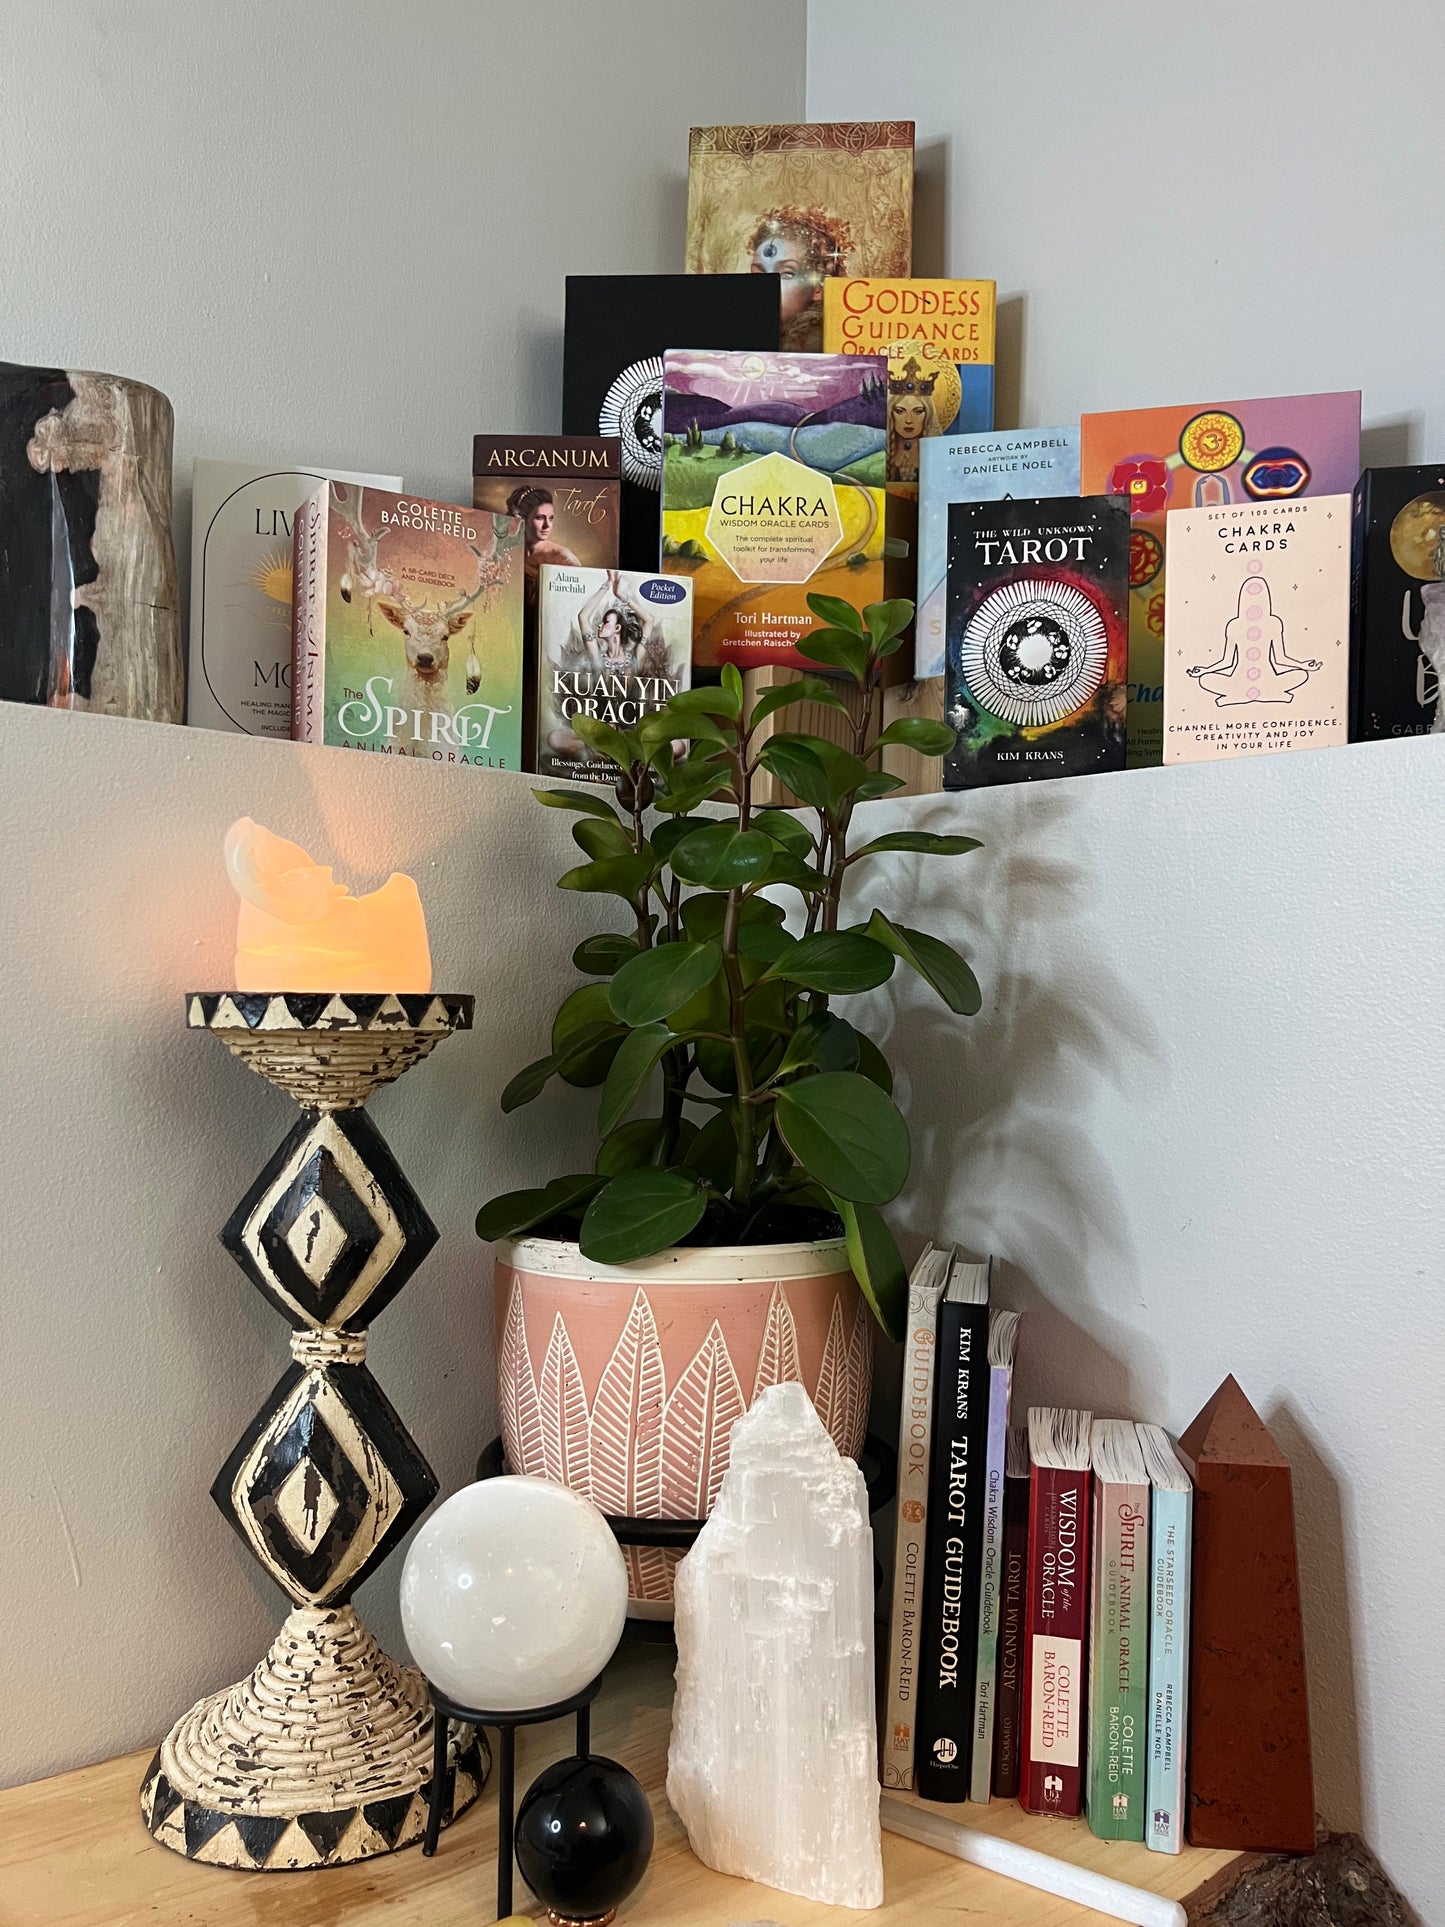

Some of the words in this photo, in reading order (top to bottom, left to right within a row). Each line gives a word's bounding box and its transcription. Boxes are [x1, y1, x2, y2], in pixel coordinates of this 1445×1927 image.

[843, 280, 980, 316] GODDESS
[842, 315, 979, 341] GUIDANCE
[842, 341, 905, 359] ORACLE
[922, 343, 979, 360] CARDS
[487, 449, 610, 467] ARCANUM
[949, 444, 1002, 455] REBECCA
[1006, 439, 1068, 451] CAMPBELL
[963, 463, 1018, 475] DANIELLE
[1022, 460, 1053, 470] NOEL
[397, 501, 461, 524] COLETTE
[554, 487, 608, 524] Tarot
[721, 496, 828, 516] CHAKRA
[1273, 505, 1308, 515] CARDS
[381, 510, 477, 540] BARON-REID
[760, 520, 796, 528] ORACLE
[798, 520, 829, 528] CARDS
[973, 530, 997, 539] THE
[1002, 528, 1031, 537] WILD
[1038, 525, 1095, 535] UNKNOWN
[1218, 522, 1295, 538] CHAKRA
[750, 536, 783, 544] complete
[785, 536, 813, 544] spiritual
[769, 546, 815, 554] transforming
[975, 537, 1093, 565] TAROT
[1225, 539, 1288, 553] CARDS
[418, 576, 456, 588] GUIDEBOOK
[438, 572, 456, 581] DECK
[549, 582, 586, 594] Fairchild
[555, 572, 580, 583] Alana
[651, 582, 676, 593] Pocket
[650, 591, 677, 601] Edition
[734, 612, 757, 624] Tori
[762, 612, 812, 625] Hartman
[722, 639, 761, 647] Gretchen
[763, 639, 798, 647] Raisch-
[745, 630, 788, 638] Illustrated
[790, 631, 801, 639] by
[343, 687, 364, 700] The
[552, 670, 629, 699] KUAN
[634, 676, 680, 701] YIN
[241, 700, 272, 708] HEALING
[337, 676, 513, 749] SPIRIT
[561, 696, 668, 725] ORACL
[1168, 723, 1220, 732] CHANNEL
[1226, 722, 1257, 730] MORE
[1195, 732, 1260, 741] CREATIVITY
[1294, 730, 1315, 738] JOY
[997, 752, 1019, 761] KIM
[1025, 751, 1064, 761] KRANS
[1268, 740, 1292, 748] LIFE
[432, 750, 506, 769] ORACLE
[551, 758, 586, 770] Blessings,
[586, 760, 620, 770] Guidance
[571, 771, 589, 780] from
[589, 772, 601, 780] the
[958, 1327, 972, 1362] KIM
[908, 1327, 936, 1476] GUIDEBOOK
[956, 1368, 970, 1419] KRANS
[947, 1436, 968, 1528] TAROT
[989, 1469, 1000, 1503] Chakra
[986, 1505, 998, 1544] Wisdom
[1118, 1503, 1144, 1572] SPIRIT
[1167, 1525, 1175, 1545] THE
[1057, 1488, 1078, 1588] WISDOM
[904, 1541, 919, 1604] COLETTE
[985, 1547, 996, 1579] Oracle
[1006, 1550, 1021, 1604] TAROT
[1041, 1552, 1056, 1619] ORACLE
[1156, 1558, 1164, 1617] GUIDEBOOK
[1166, 1550, 1174, 1606] STARSEED
[1060, 1589, 1071, 1600] of
[1062, 1600, 1072, 1611] the
[1108, 1560, 1116, 1634] GUIDEBOOK
[1119, 1575, 1131, 1632] ANIMAL
[939, 1537, 964, 1689] GUIDEBOOK
[982, 1583, 995, 1635] Guidebook
[1164, 1611, 1173, 1655] ORACLE
[899, 1610, 915, 1701] BARON-REID
[1003, 1609, 1019, 1689] ARCANUM
[1119, 1637, 1130, 1693] ORACLE
[980, 1680, 990, 1698] Tori
[1042, 1651, 1056, 1748] BARON-REID
[1056, 1665, 1070, 1739] COLETTE
[1165, 1683, 1173, 1723] REBECCA
[978, 1700, 989, 1739] Hartman
[1108, 1706, 1119, 1783] BARON-REID
[1122, 1715, 1133, 1775] COLETTE
[1154, 1736, 1162, 1760] NOEL
[1164, 1726, 1172, 1772] CAMPBELL
